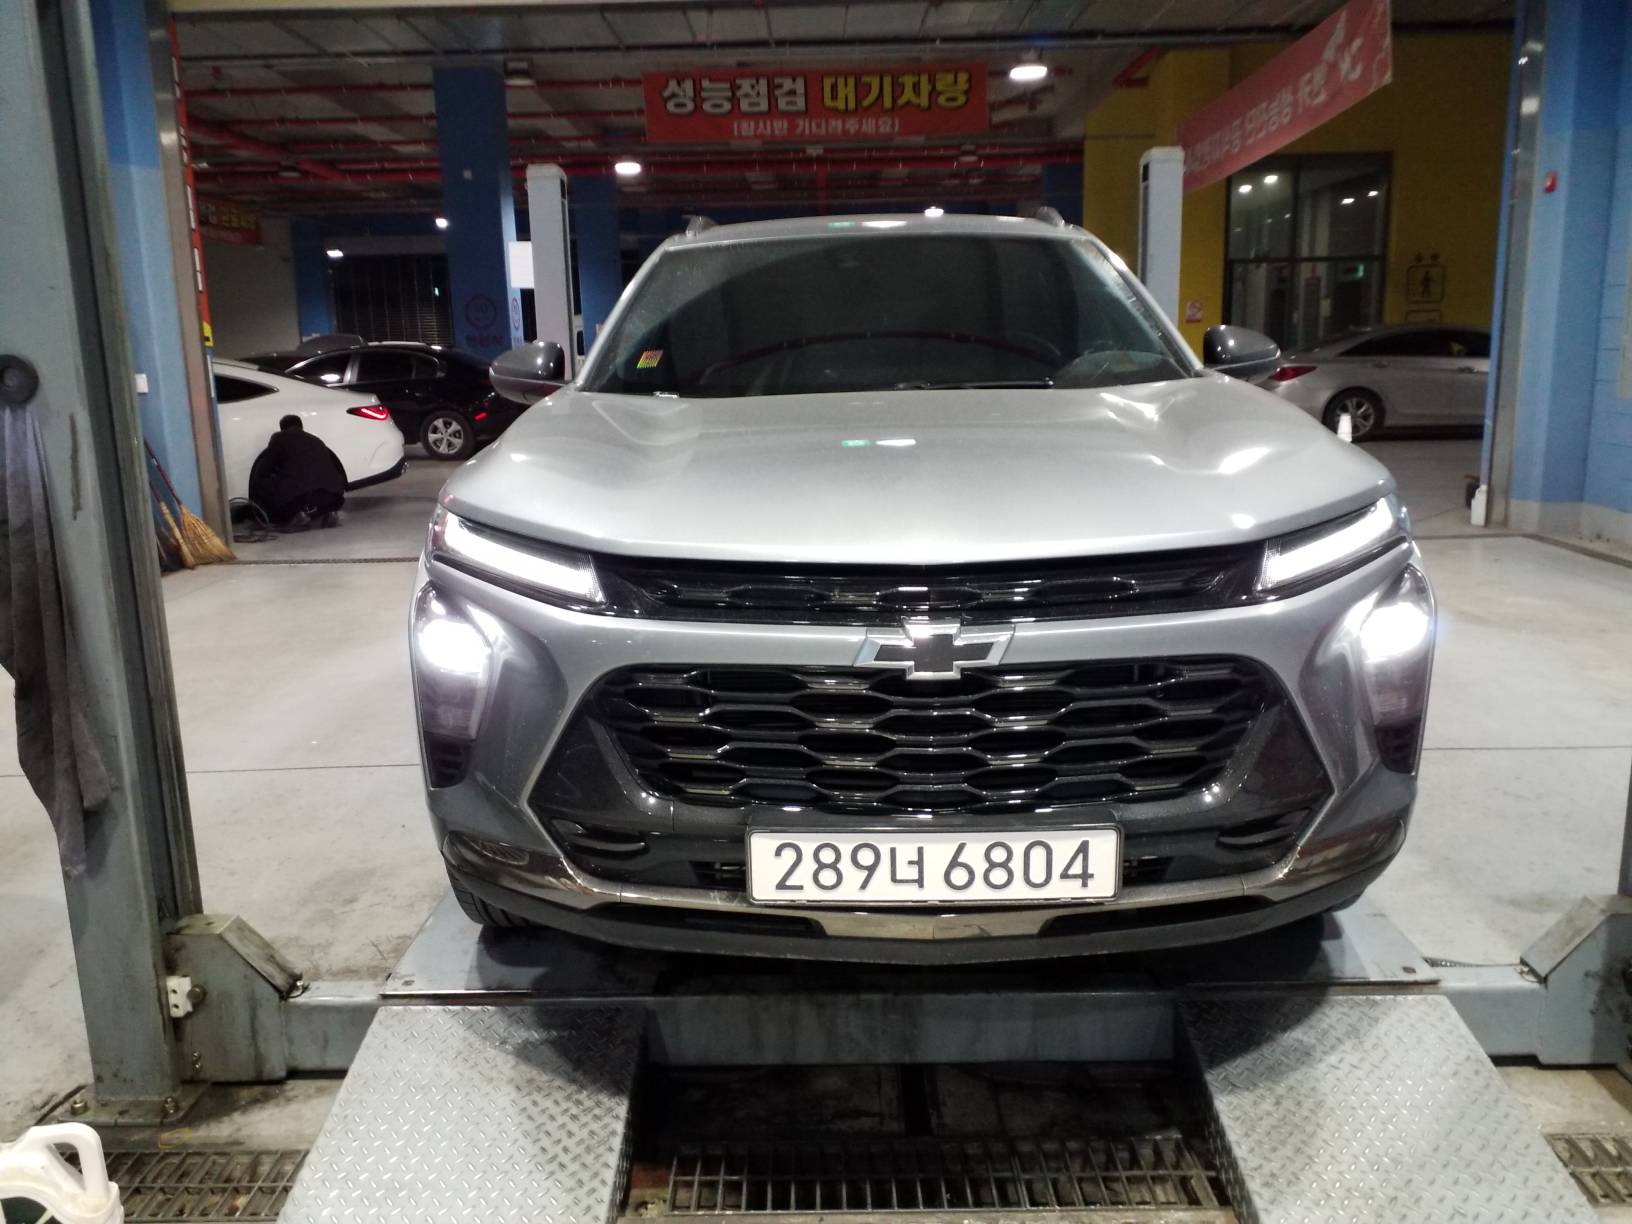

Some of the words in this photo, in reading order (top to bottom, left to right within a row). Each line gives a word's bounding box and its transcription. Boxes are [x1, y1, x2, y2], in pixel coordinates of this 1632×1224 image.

[662, 75, 807, 115] 성능점검
[822, 70, 971, 113] 대기차량
[774, 842, 925, 891] 289너
[943, 839, 1095, 891] 6804
